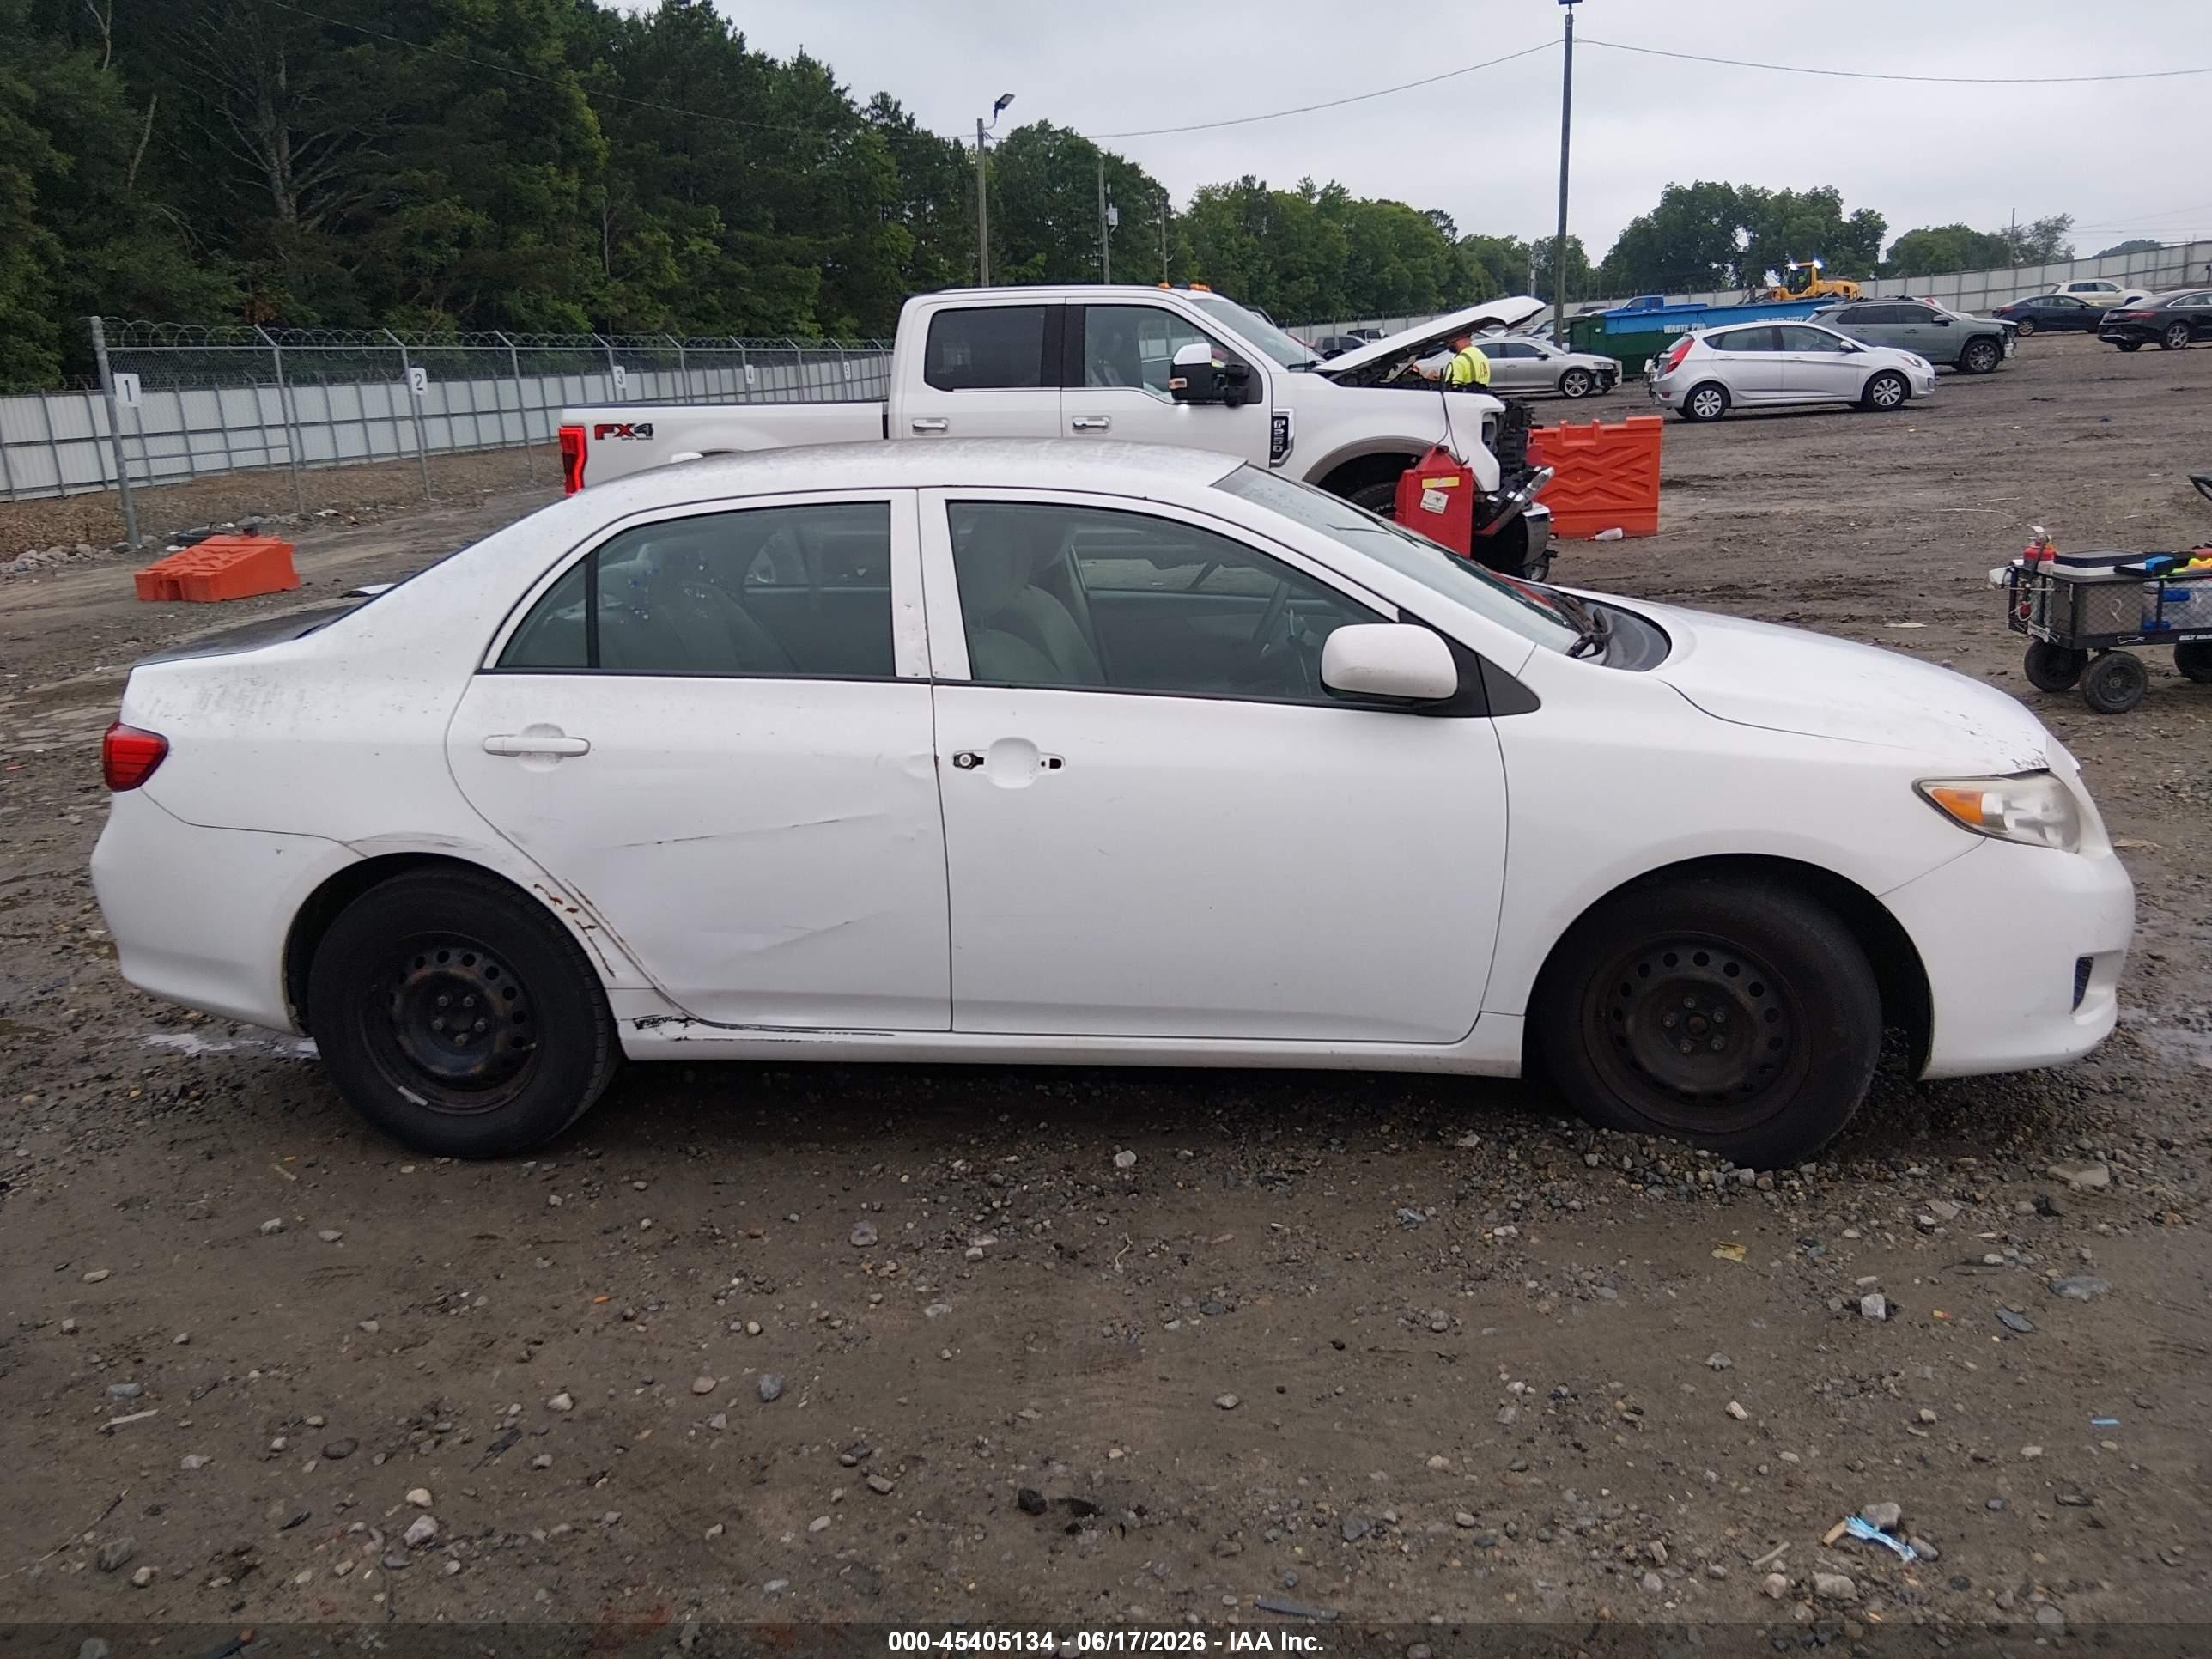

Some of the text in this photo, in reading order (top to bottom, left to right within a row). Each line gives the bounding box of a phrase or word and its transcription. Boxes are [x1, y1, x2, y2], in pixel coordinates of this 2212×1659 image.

[414, 373, 423, 391] 2
[617, 370, 624, 386] 3
[124, 379, 132, 402] 1
[594, 423, 653, 440] FX4
